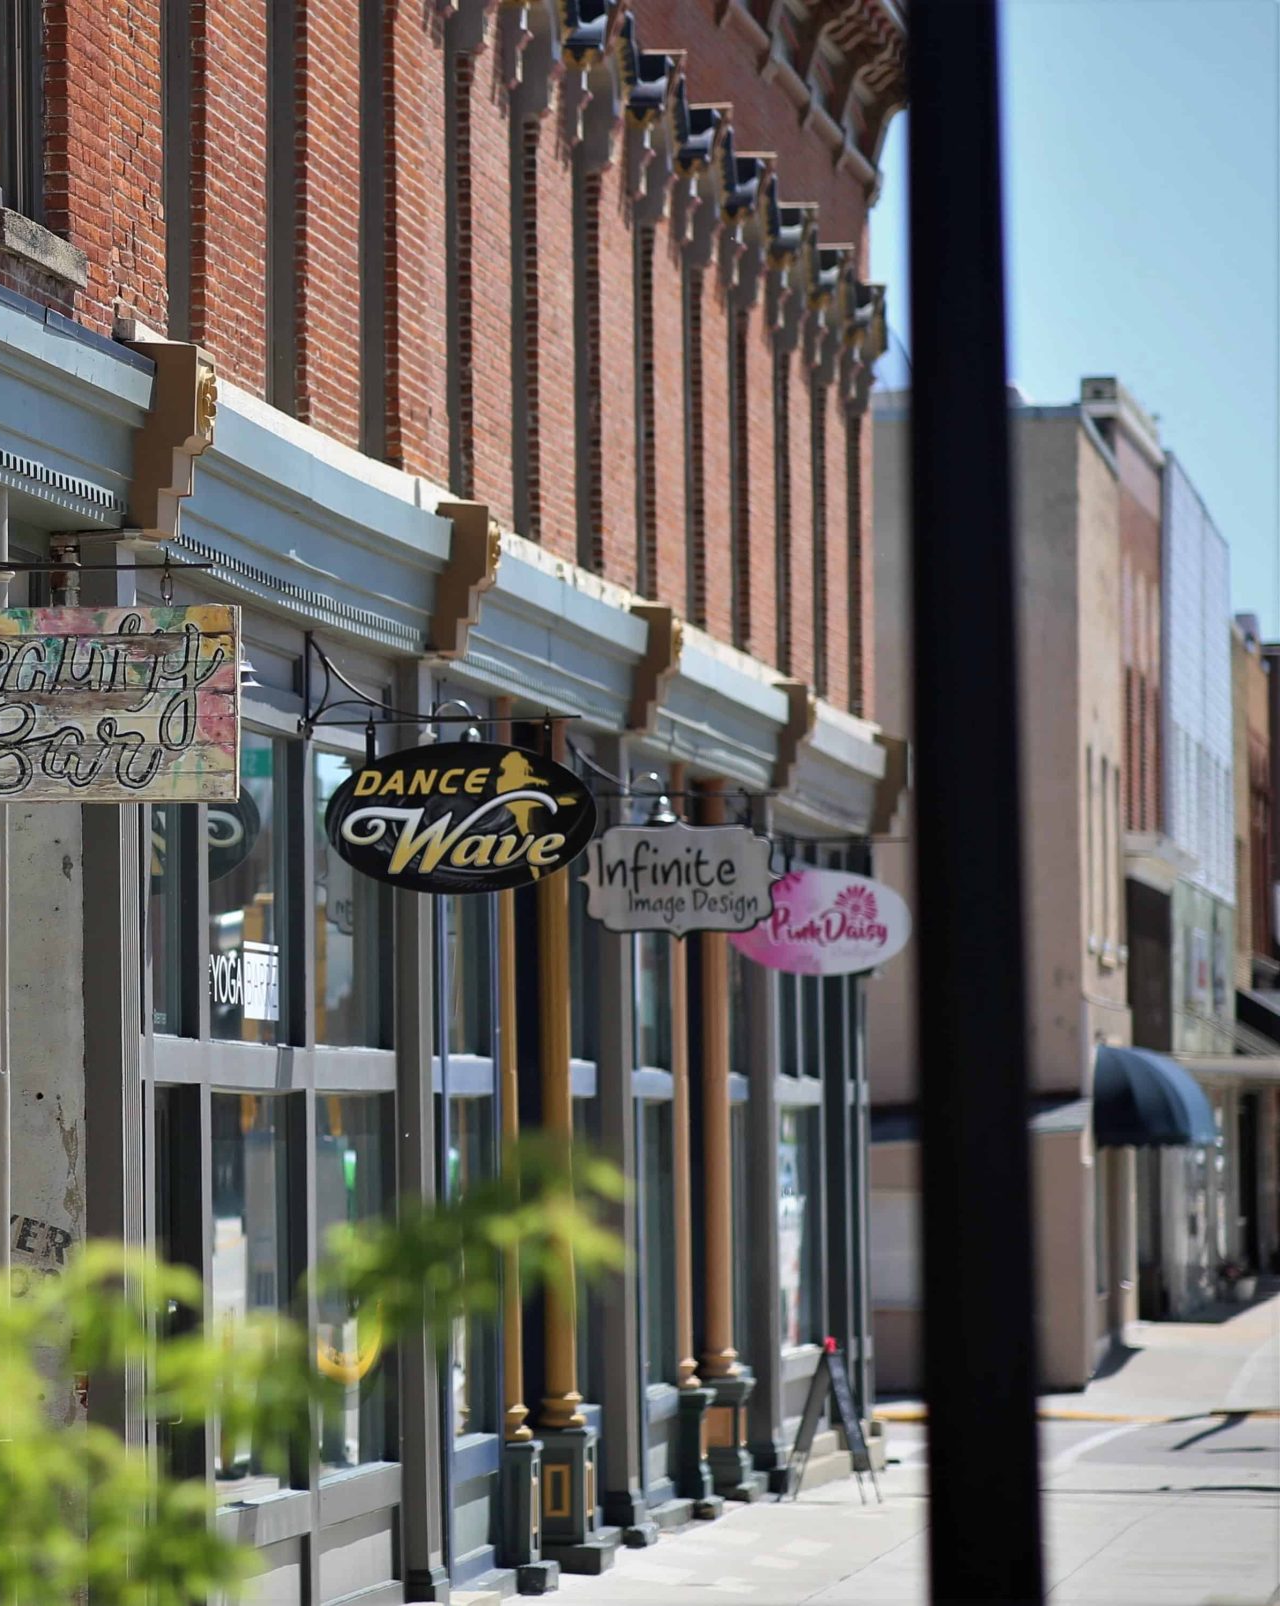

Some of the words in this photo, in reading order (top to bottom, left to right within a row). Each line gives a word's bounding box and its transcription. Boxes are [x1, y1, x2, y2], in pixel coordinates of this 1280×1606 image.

[353, 767, 491, 796] DANCE
[341, 790, 566, 874] Wave
[596, 841, 736, 895] Infinite
[628, 892, 685, 923] Image
[692, 888, 758, 923] Design
[772, 907, 825, 947] Pink
[821, 908, 887, 948] Daisy
[210, 954, 244, 1006] YOGA
[10, 1214, 71, 1265] ER
